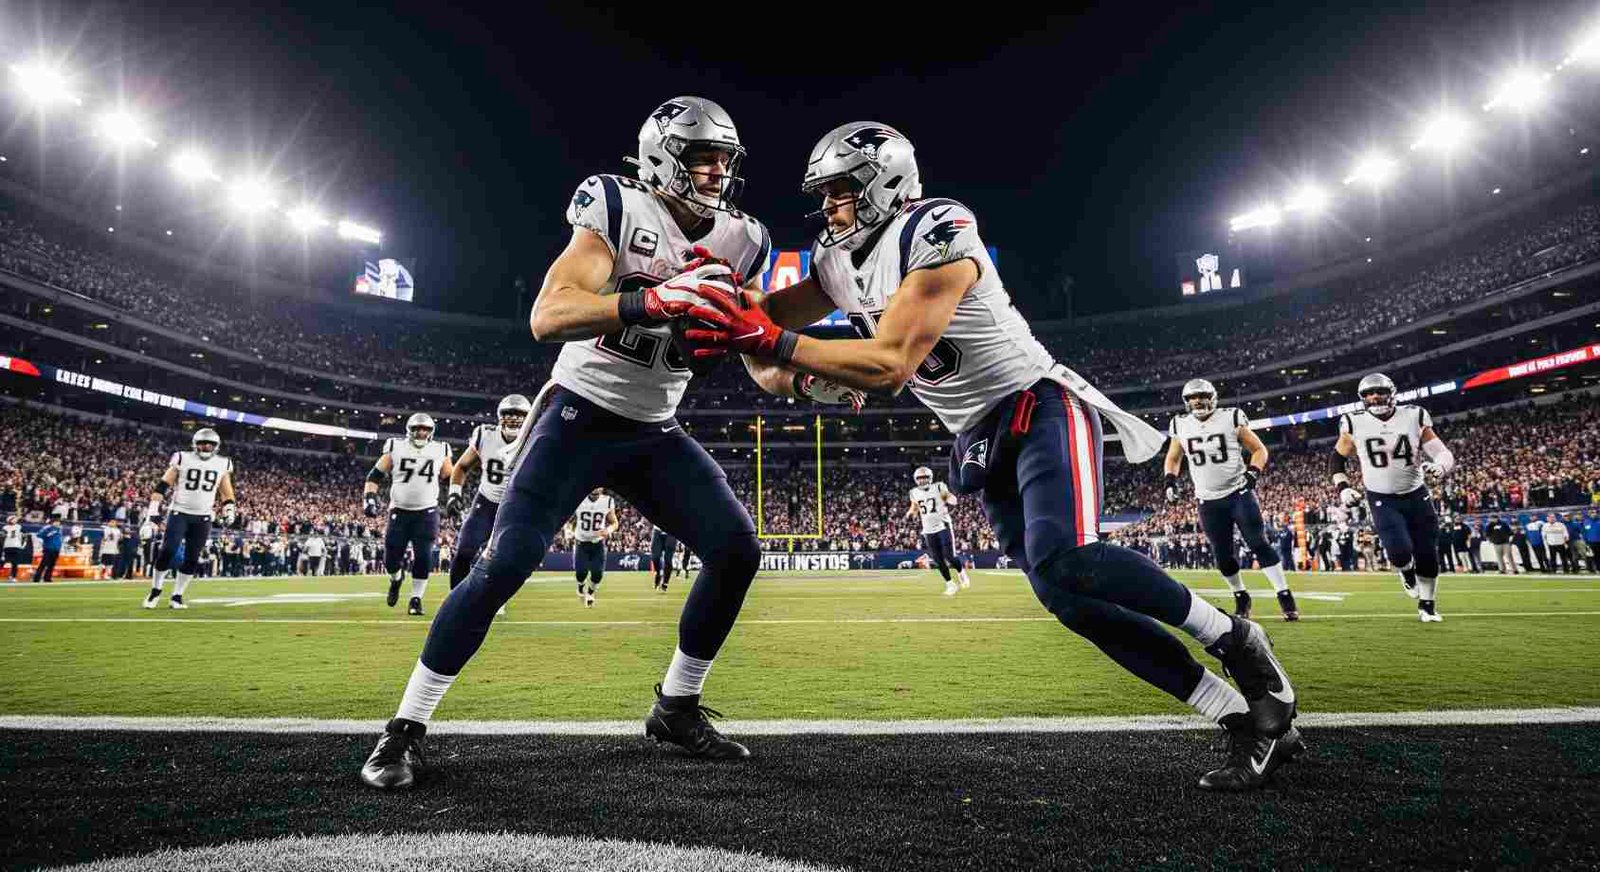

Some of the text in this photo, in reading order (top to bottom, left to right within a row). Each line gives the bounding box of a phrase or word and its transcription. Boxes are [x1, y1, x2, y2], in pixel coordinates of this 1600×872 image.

[1187, 433, 1228, 466] 53
[1365, 434, 1414, 468] 64
[185, 468, 217, 492] 99
[400, 458, 434, 483] 54
[918, 497, 937, 515] 57
